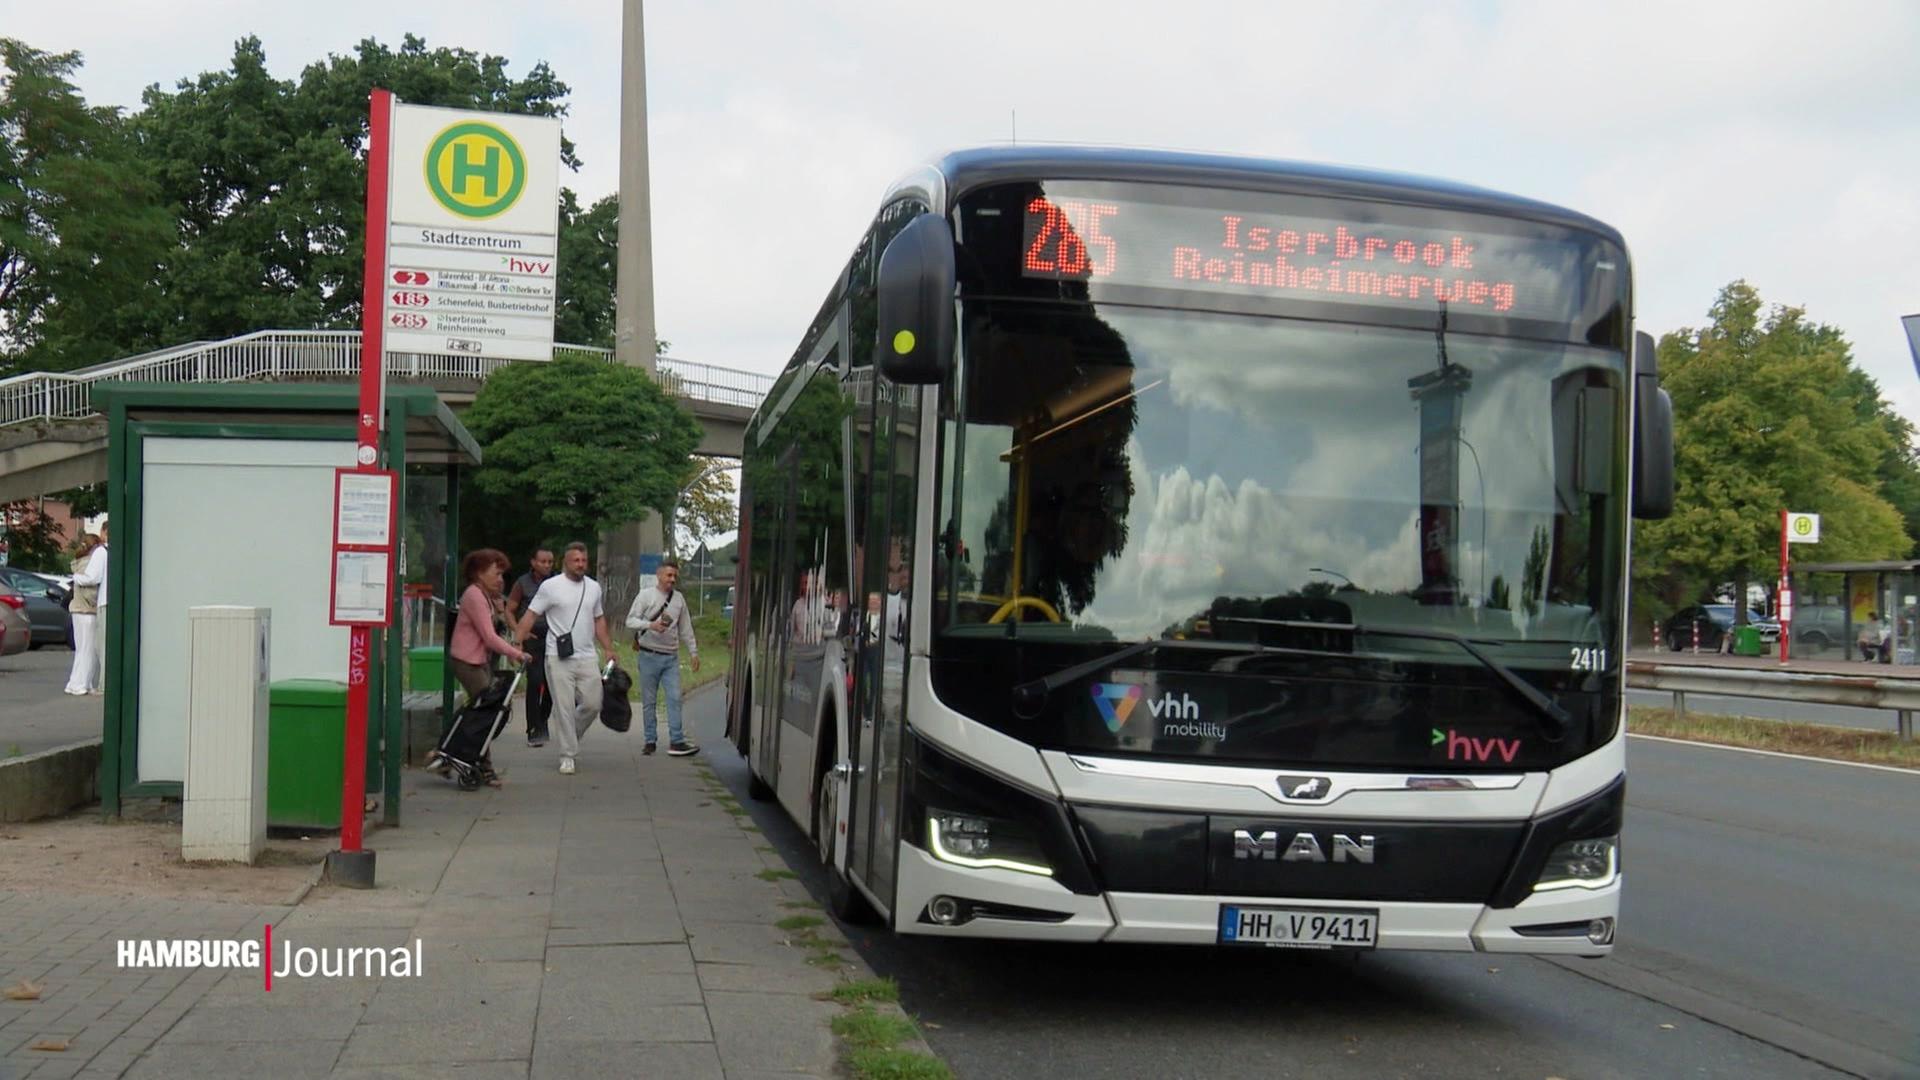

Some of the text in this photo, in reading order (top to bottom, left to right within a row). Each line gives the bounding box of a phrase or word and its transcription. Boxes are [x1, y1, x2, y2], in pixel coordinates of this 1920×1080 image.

[452, 143, 500, 198] H
[421, 229, 522, 249] Stadtzentrum
[1025, 198, 1118, 277] 285
[1222, 215, 1474, 270] Iserbrook
[407, 272, 416, 284] 2
[1173, 246, 1516, 312] Reinheimerweg
[398, 292, 425, 307] 185
[487, 300, 550, 313] Busbetriebshof
[396, 313, 424, 328] 285
[437, 324, 506, 336] Reinheimerweg
[445, 316, 487, 325] Iserbrook
[1570, 647, 1607, 672] 2411
[1147, 691, 1200, 720] vhh
[1164, 721, 1227, 742] mobility
[1447, 729, 1521, 763] hvv
[1233, 829, 1376, 865] MAN
[1238, 913, 1372, 942] HH V 9411
